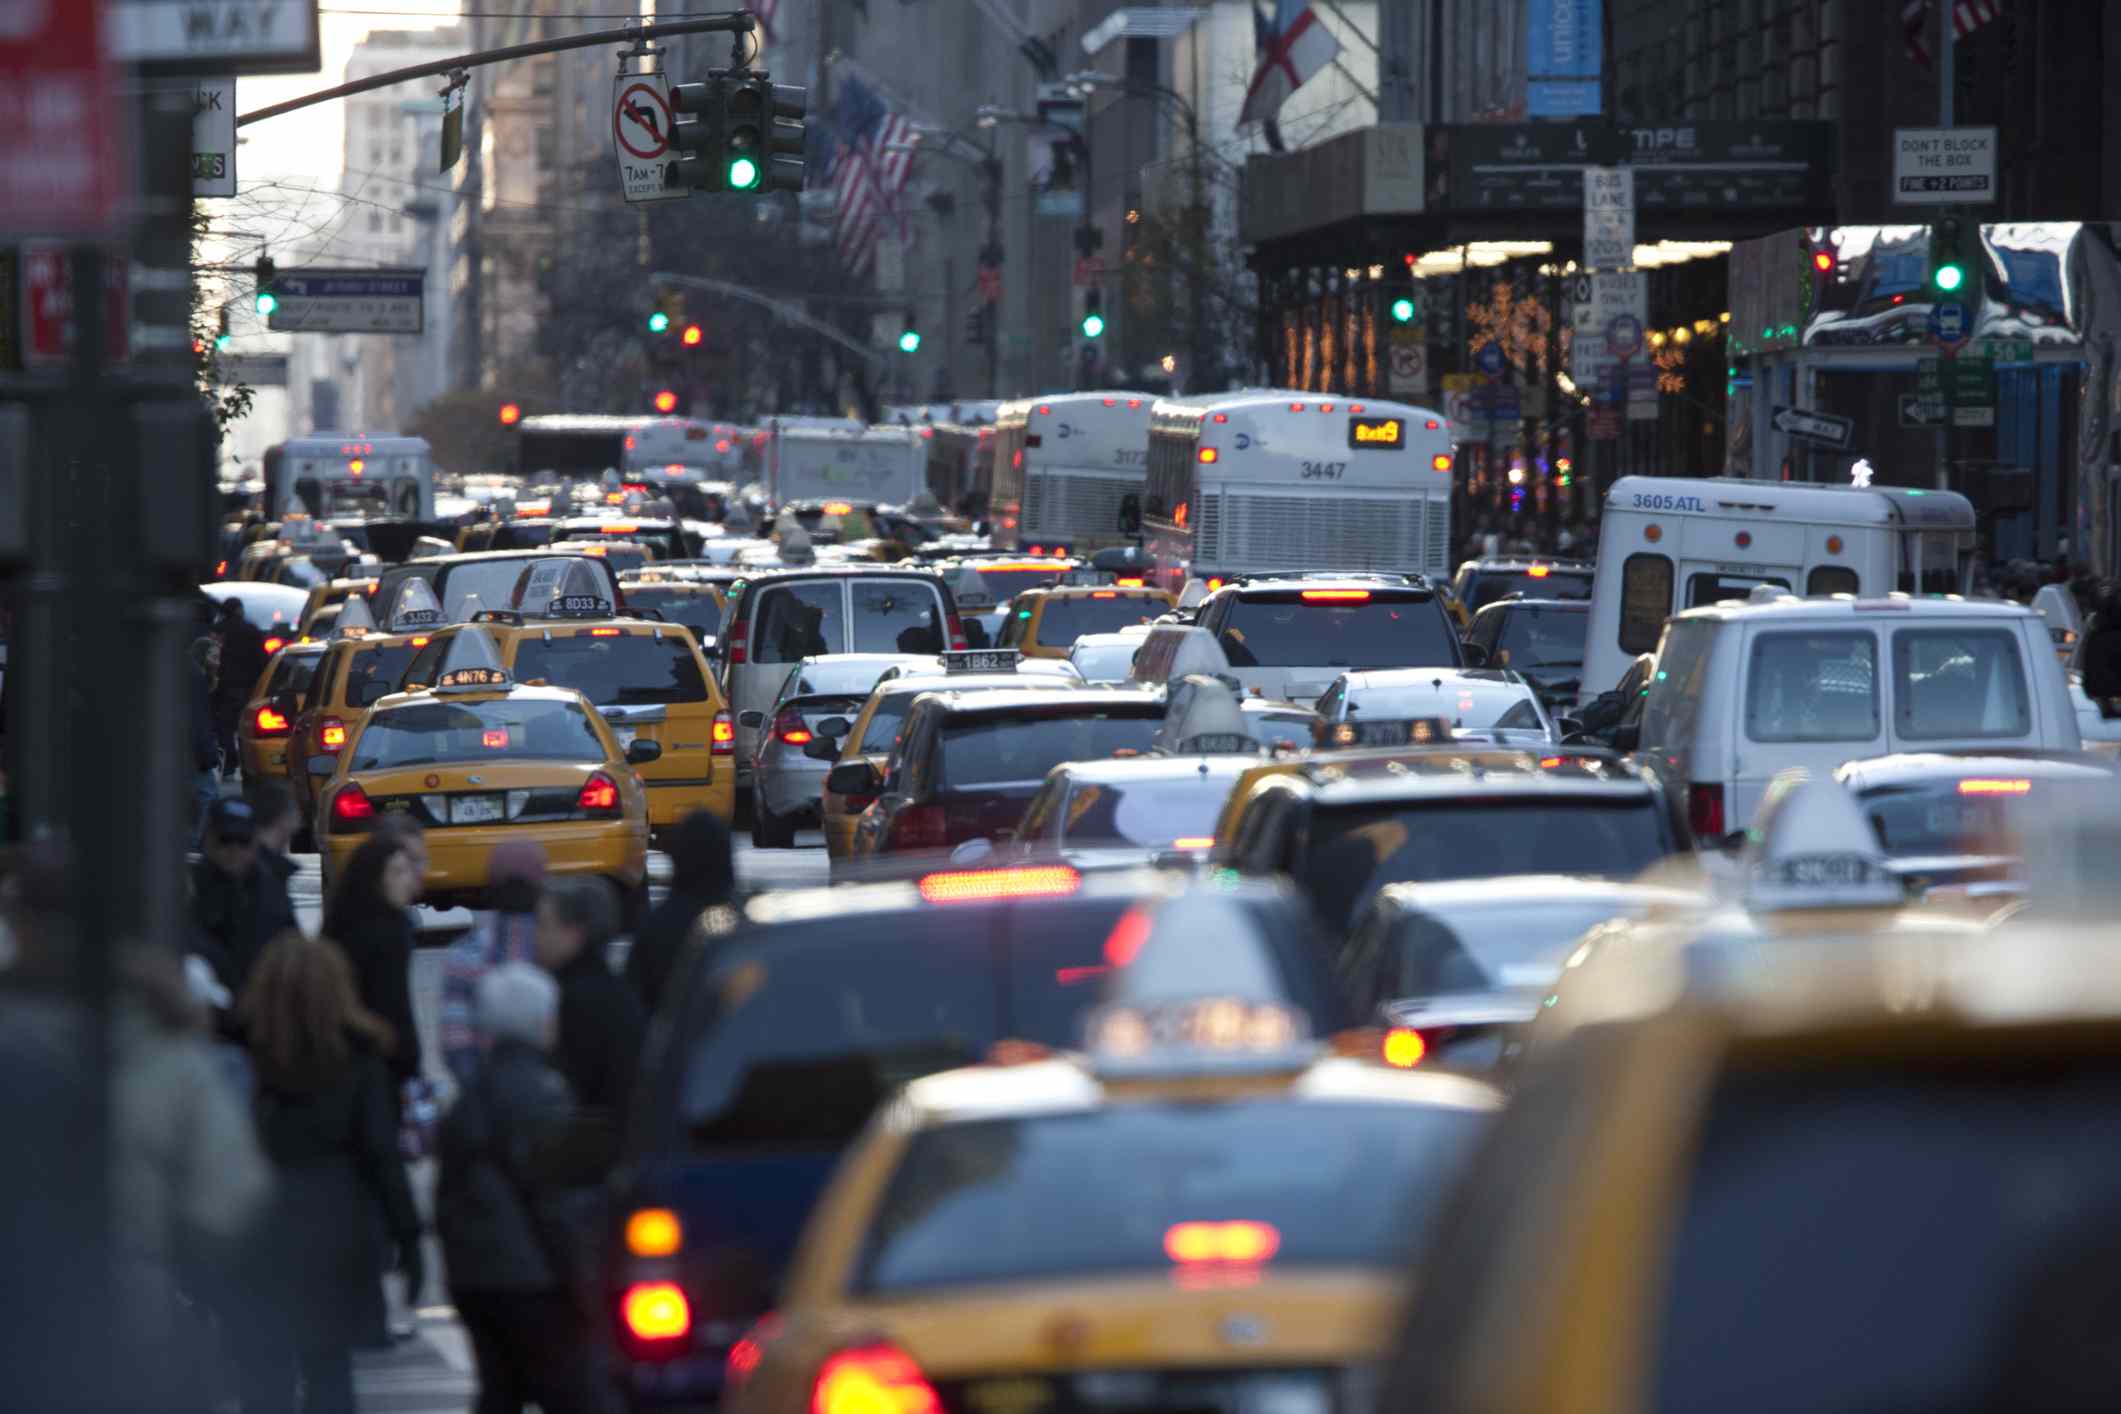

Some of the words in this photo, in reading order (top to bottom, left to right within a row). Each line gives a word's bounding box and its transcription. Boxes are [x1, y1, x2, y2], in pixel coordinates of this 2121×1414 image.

[1903, 138, 1940, 152] DON'T
[1944, 138, 1987, 151] BLOCK
[1918, 155, 1942, 167] THE
[1946, 154, 1973, 167] BOX
[1301, 461, 1346, 480] 3447
[566, 597, 594, 609] 8D33
[964, 653, 999, 668] 1B62
[456, 670, 487, 684] 4N76
